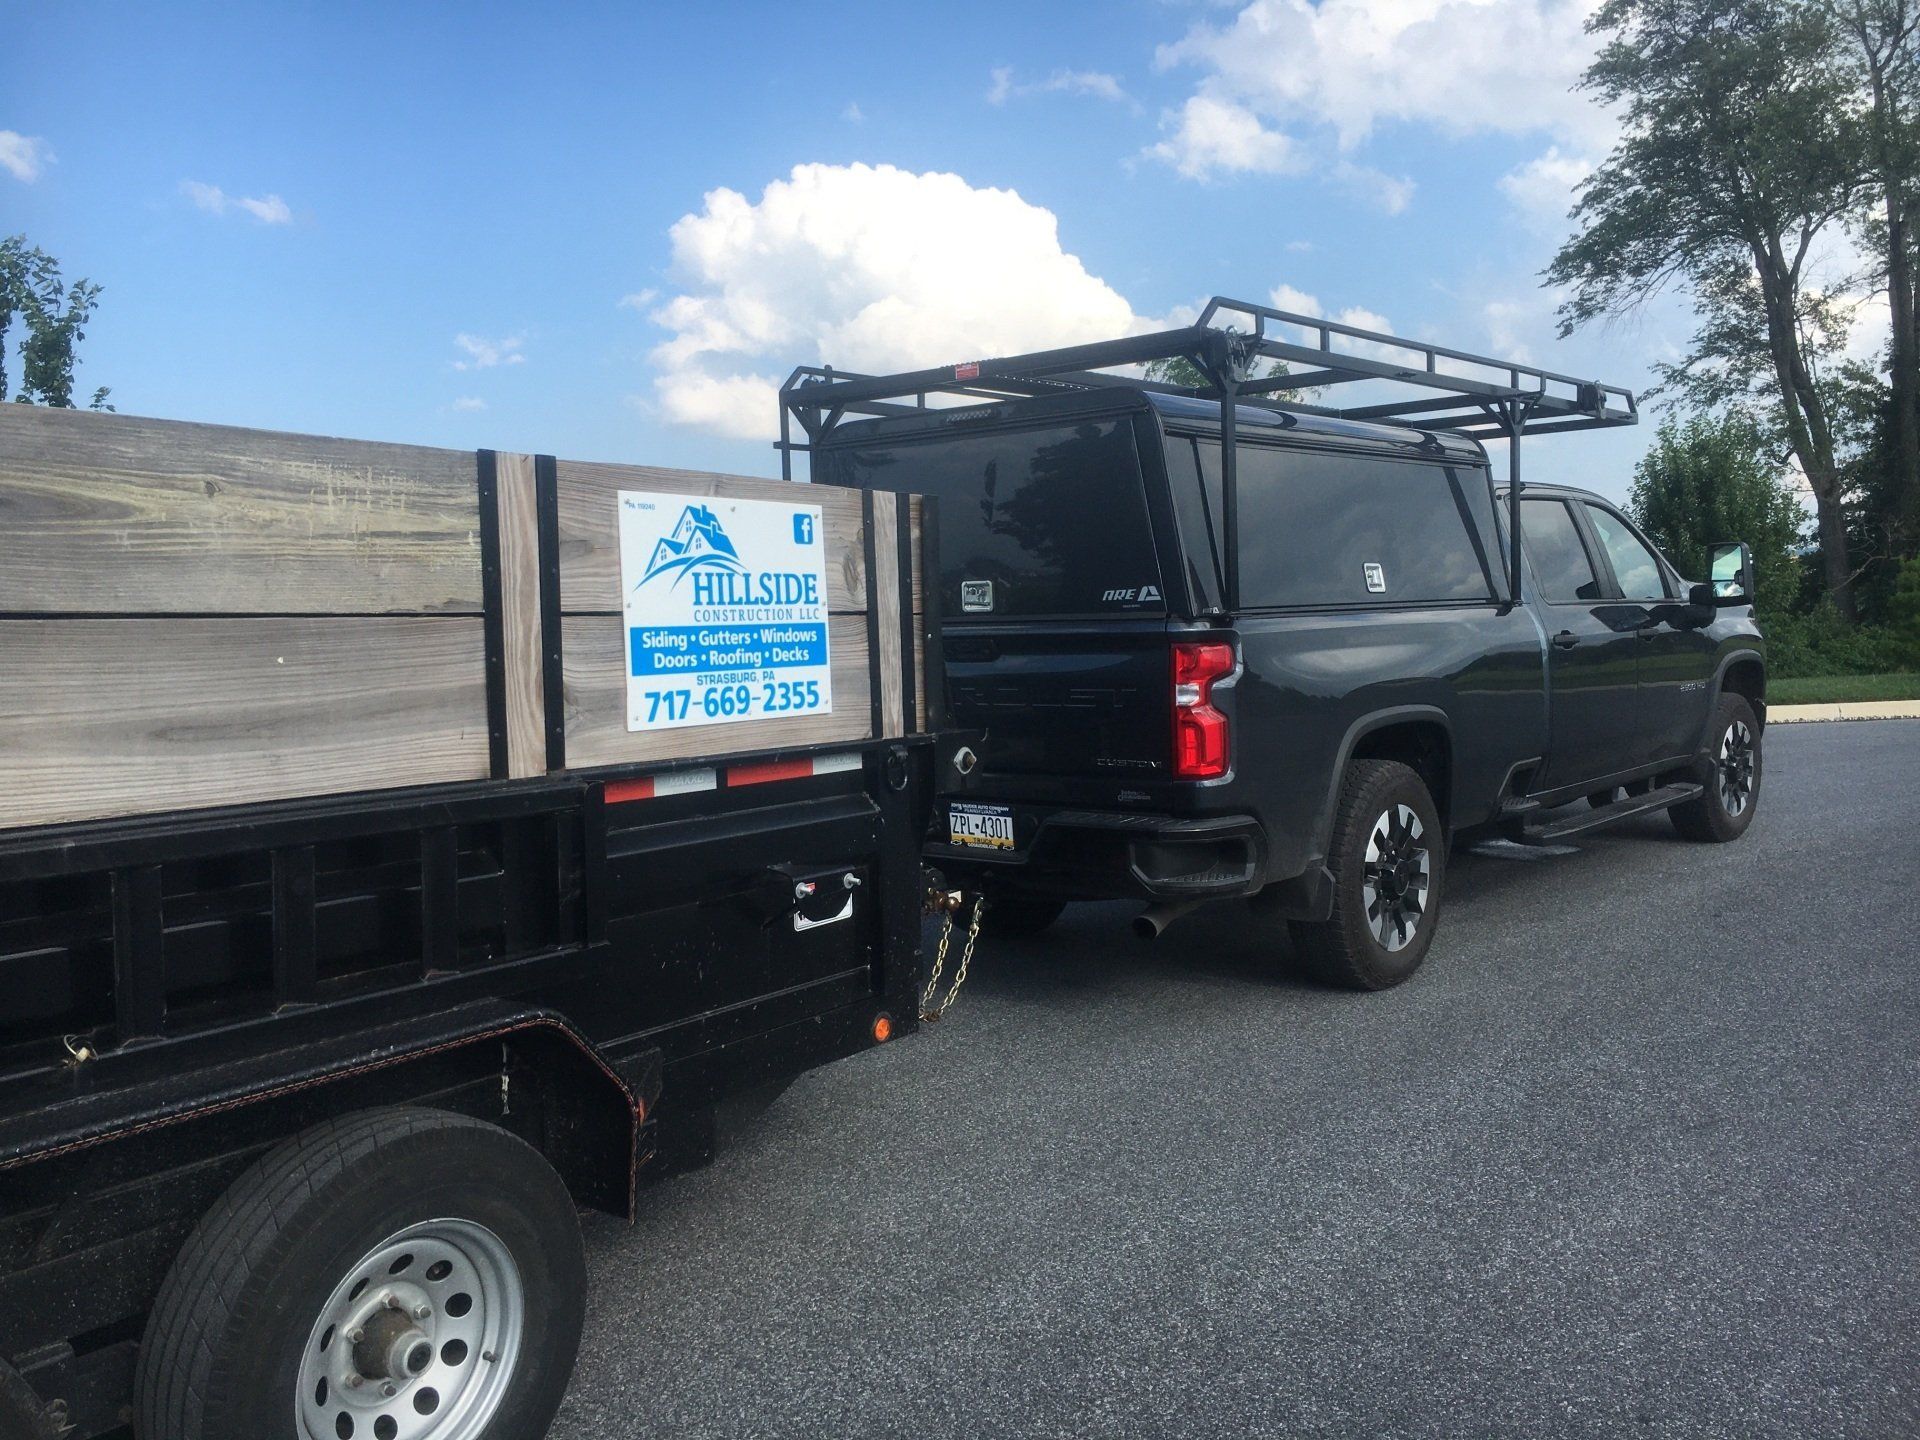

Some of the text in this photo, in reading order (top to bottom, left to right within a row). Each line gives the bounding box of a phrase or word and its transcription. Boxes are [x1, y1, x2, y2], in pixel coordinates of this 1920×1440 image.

[691, 572, 819, 606] HILLSIDE
[694, 607, 820, 623] CONSTRUCTION LLC
[642, 629, 818, 651] Siding Gutters Windows
[653, 648, 809, 669] Doors Roofing Decks
[696, 671, 775, 686] STRASBURG, PA
[644, 680, 819, 723] 717-669-2355
